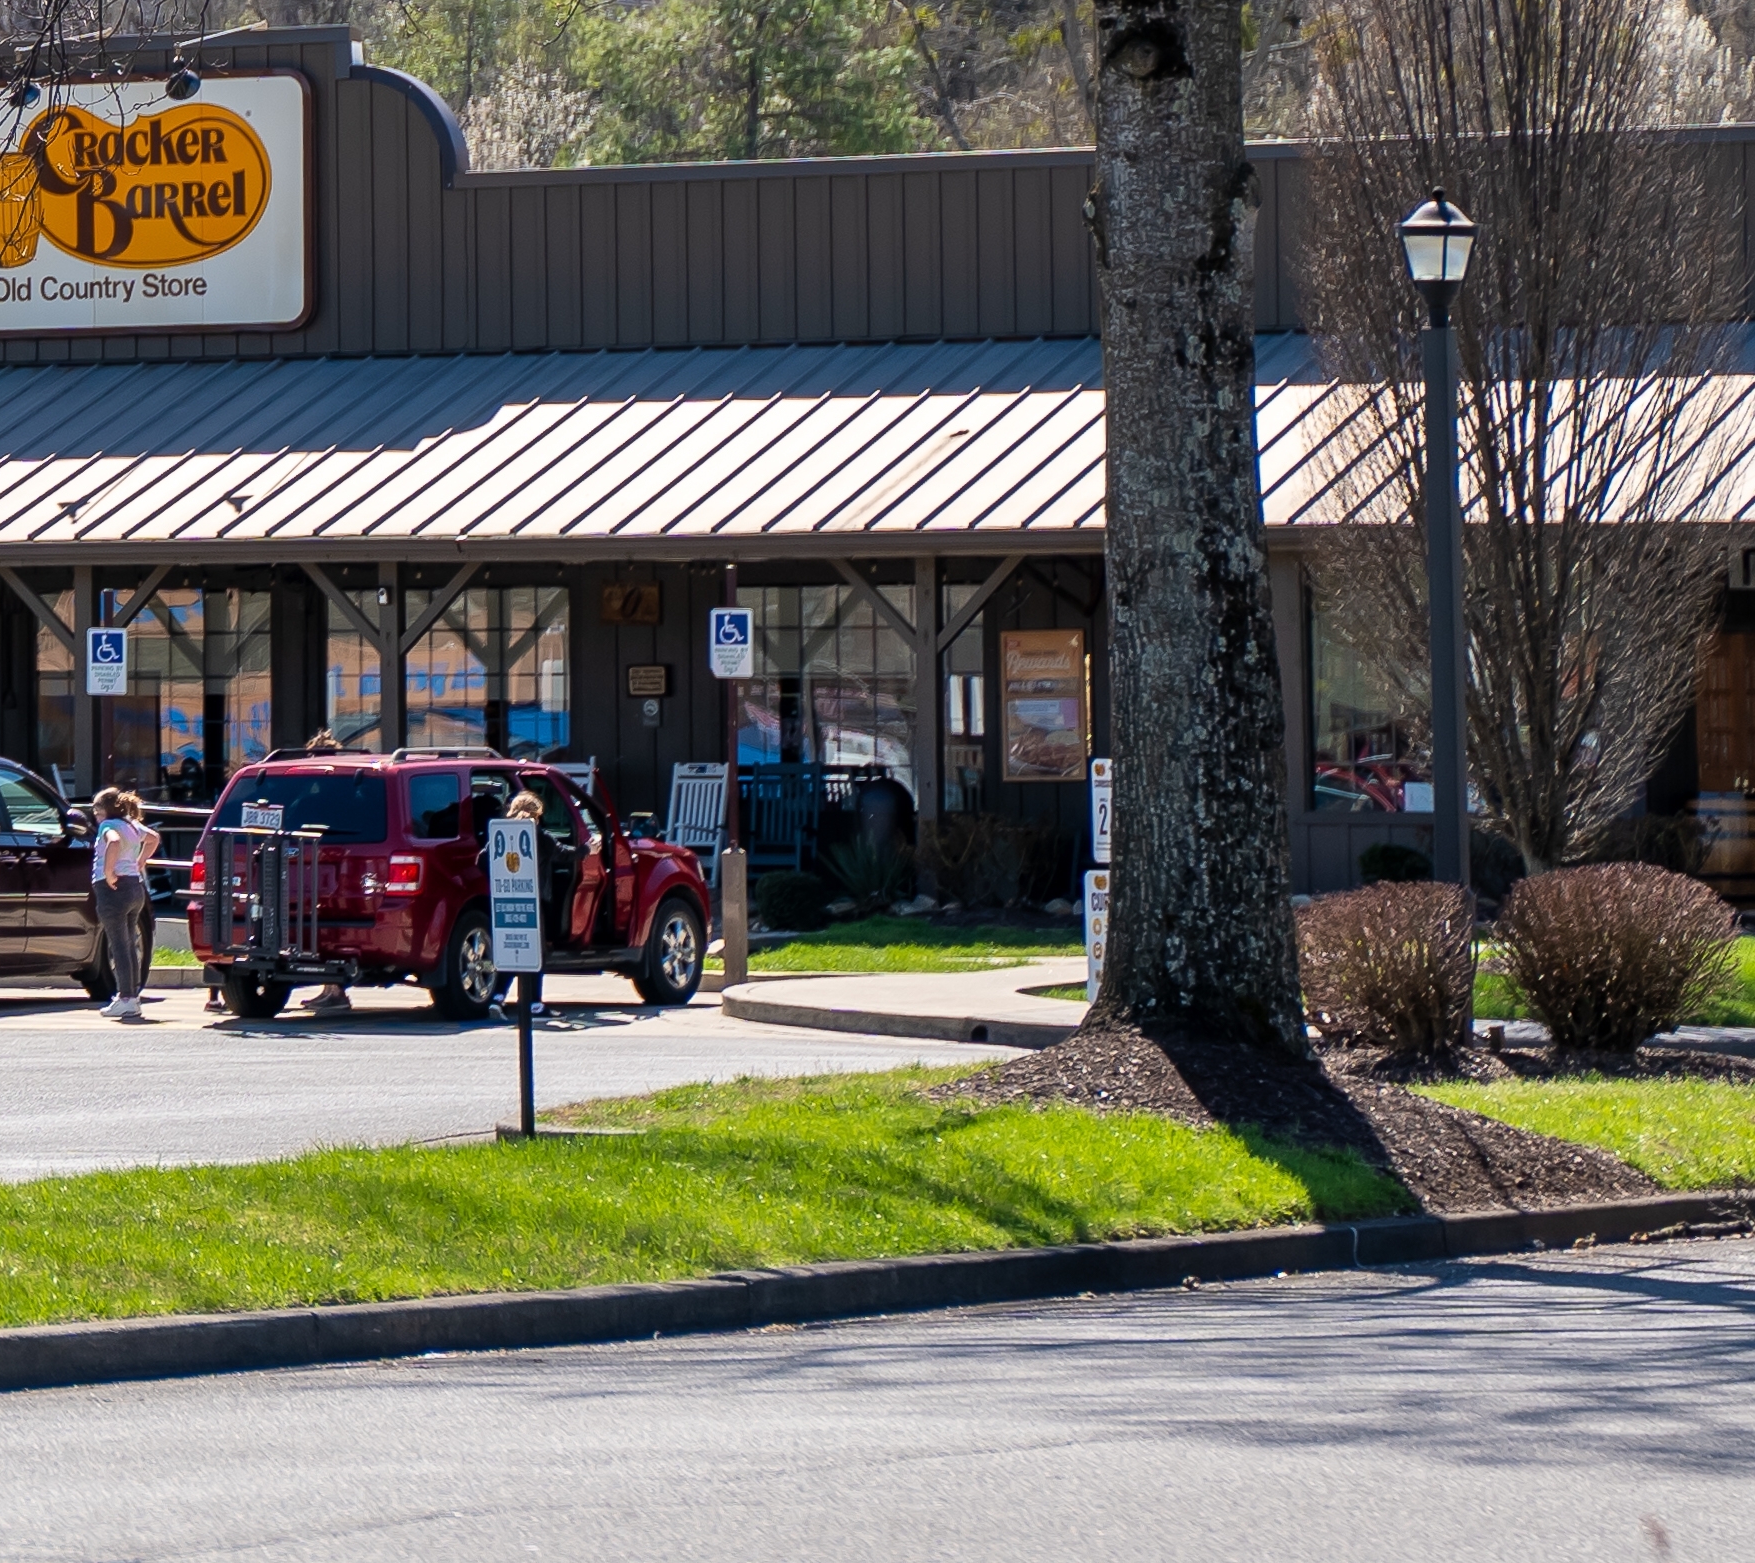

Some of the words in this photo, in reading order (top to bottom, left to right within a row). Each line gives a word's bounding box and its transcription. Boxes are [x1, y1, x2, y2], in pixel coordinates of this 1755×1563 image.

[22, 112, 228, 195] Cracker
[75, 169, 247, 258] Barrel
[39, 275, 136, 305] Country
[142, 273, 208, 299] Store
[1098, 803, 1108, 836] 2
[496, 834, 503, 850] 3
[521, 834, 528, 850] 4
[511, 879, 534, 893] PARKING
